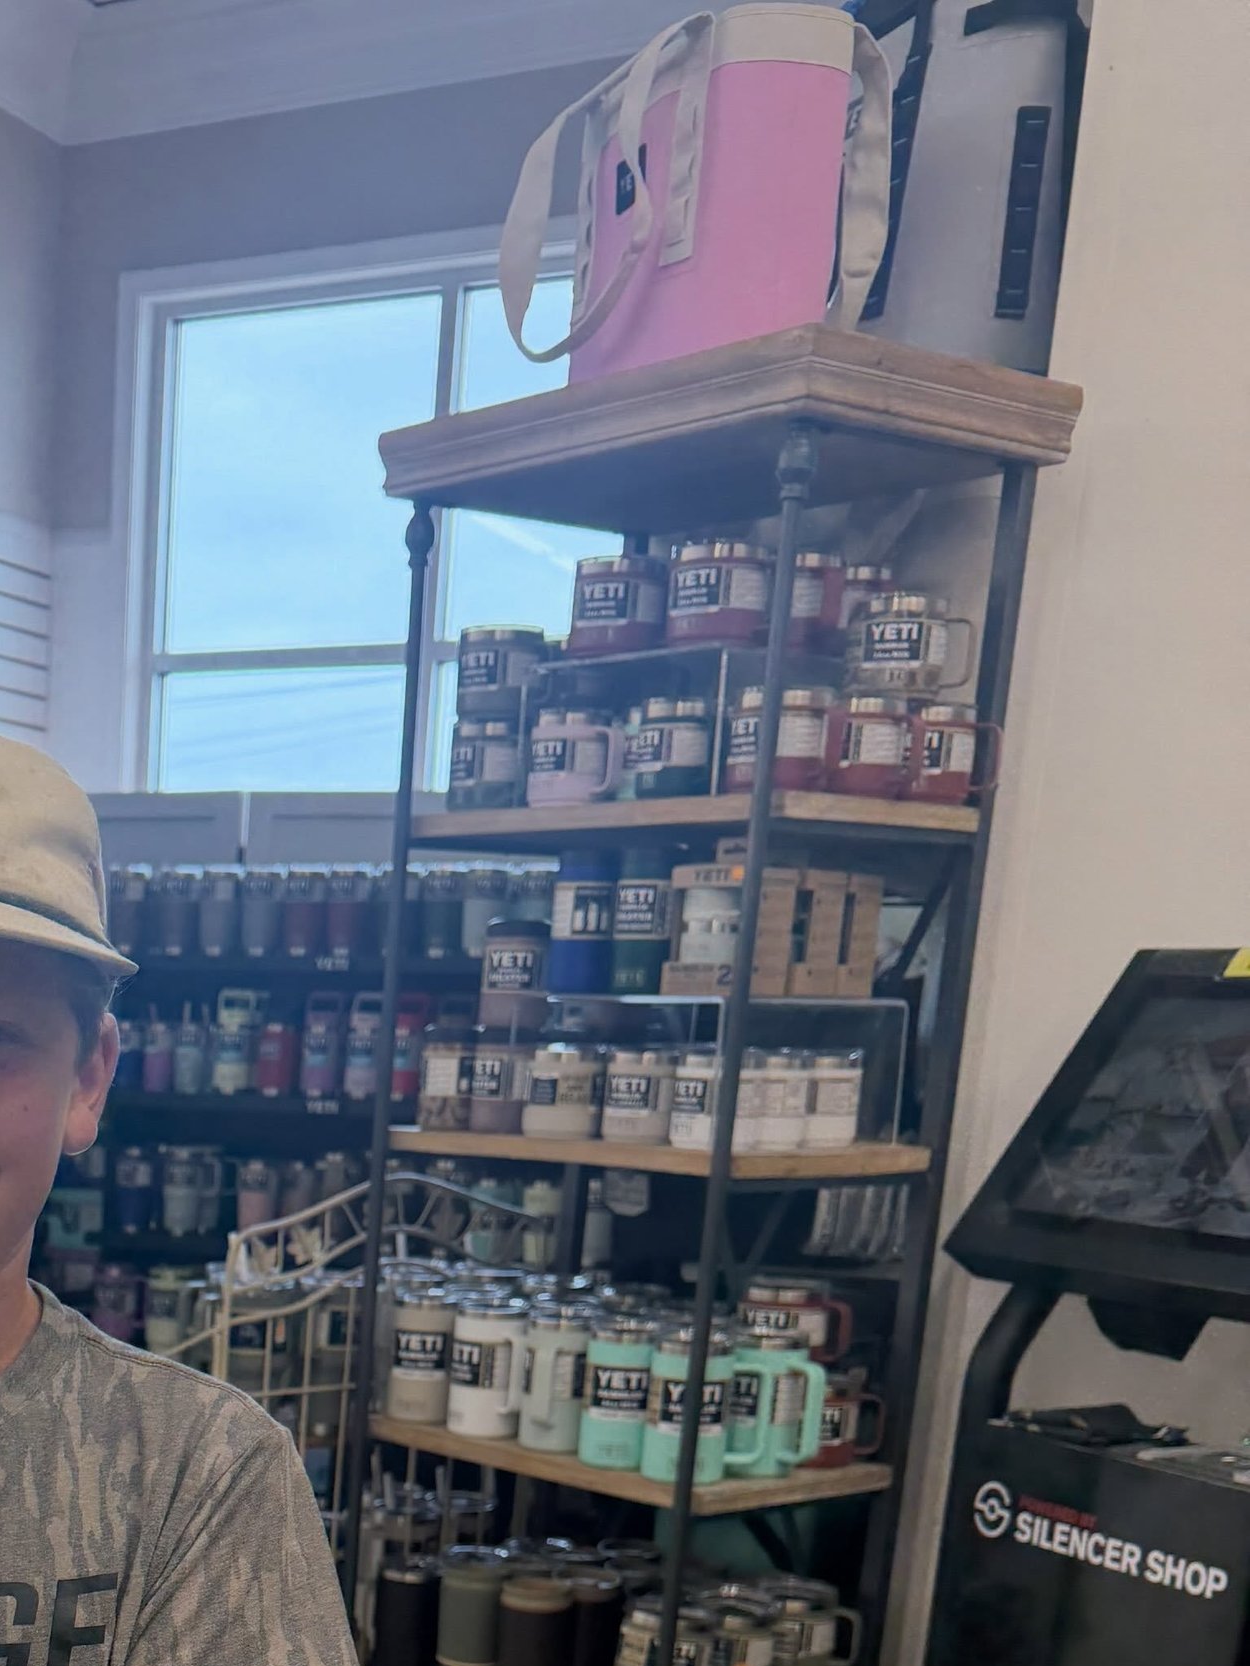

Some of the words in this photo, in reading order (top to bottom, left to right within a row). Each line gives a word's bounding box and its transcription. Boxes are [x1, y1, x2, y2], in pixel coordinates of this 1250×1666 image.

[676, 568, 718, 588] YETI
[583, 583, 625, 599] YETI
[871, 624, 918, 641] YETI
[619, 887, 655, 904] YETI
[490, 951, 534, 968] YETI
[610, 1076, 648, 1092] YETI
[748, 1310, 788, 1327] YETI
[398, 1332, 443, 1351] YETI
[597, 1370, 648, 1390] YETI
[668, 1381, 722, 1406] YTI
[1014, 1511, 1143, 1577] SILENCER
[1144, 1549, 1228, 1599] SHOP
